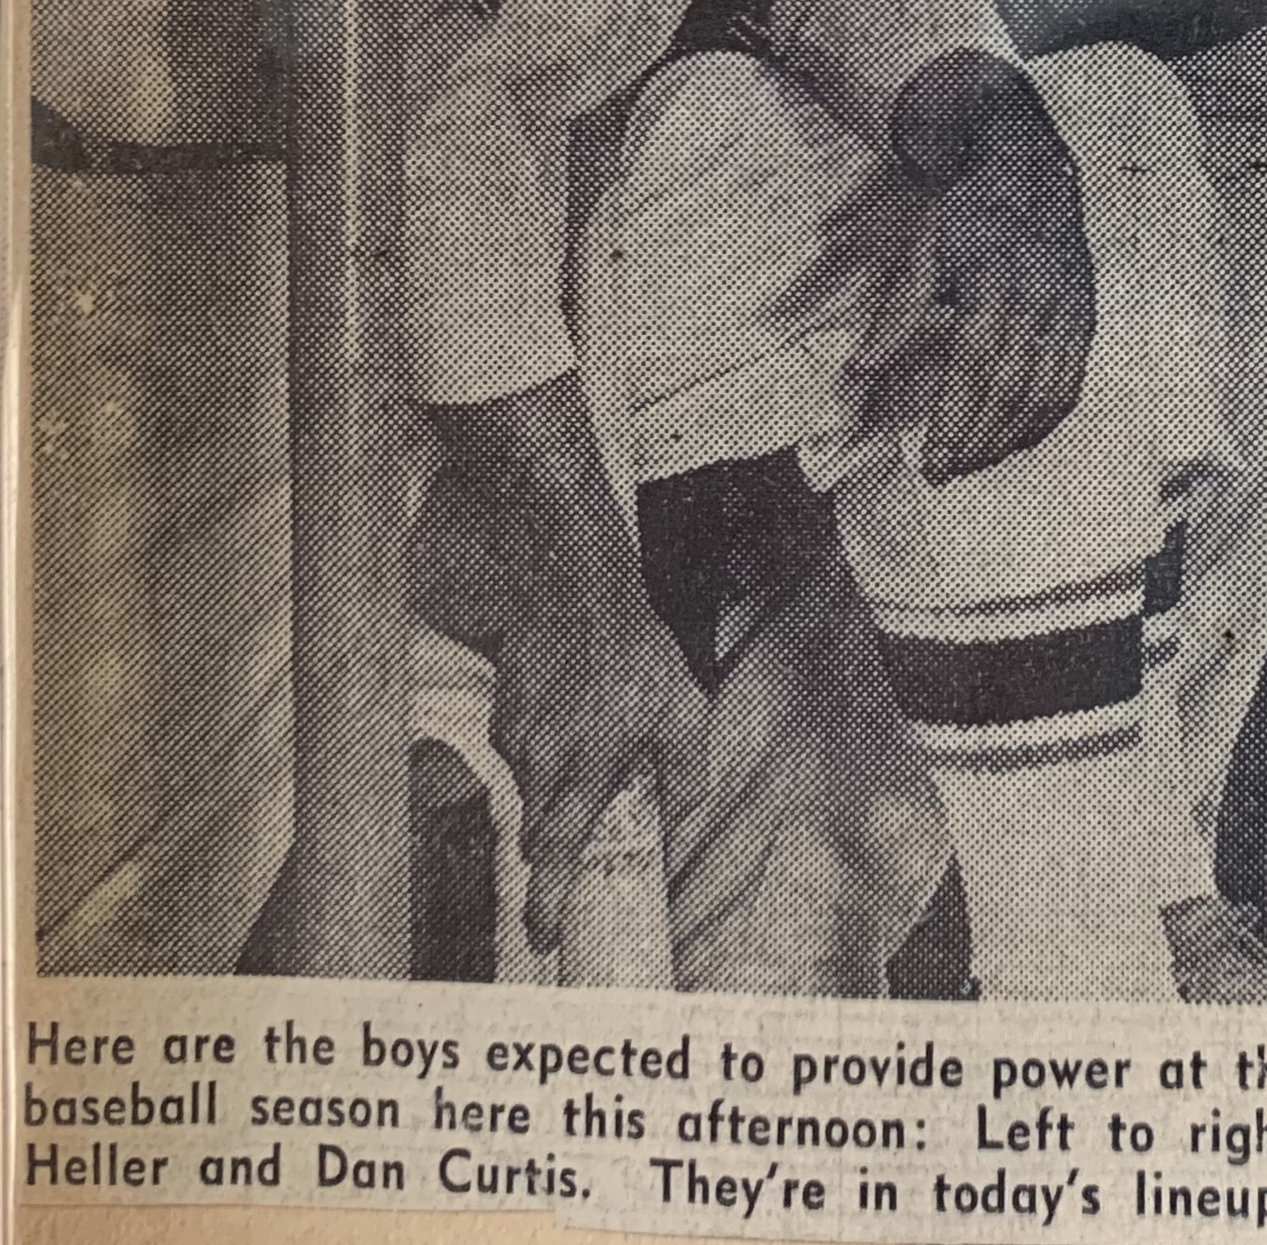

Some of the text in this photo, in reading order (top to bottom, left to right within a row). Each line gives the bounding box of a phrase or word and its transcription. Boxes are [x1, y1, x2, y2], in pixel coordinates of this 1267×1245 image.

[28, 1021, 135, 1066] Here
[163, 1034, 235, 1065] are
[264, 1019, 335, 1066] the
[362, 1020, 460, 1080] boys
[486, 1033, 691, 1086] expected
[720, 1042, 765, 1083] to
[792, 1040, 963, 1096] provide
[992, 1057, 1131, 1100] power
[1159, 1050, 1208, 1090] at
[24, 1080, 217, 1127] baseball
[250, 1095, 399, 1128] season
[434, 1085, 530, 1135] here
[562, 1091, 645, 1140] this
[677, 1098, 926, 1151] afternoon:
[977, 1103, 1075, 1153] Left
[1107, 1113, 1155, 1153] to
[26, 1141, 169, 1188] Heller
[199, 1141, 281, 1187] and
[318, 1143, 404, 1191] Dan
[438, 1147, 591, 1200] Curtis.
[649, 1157, 826, 1219] They're
[859, 1165, 898, 1212] in
[933, 1167, 1101, 1227] today's
